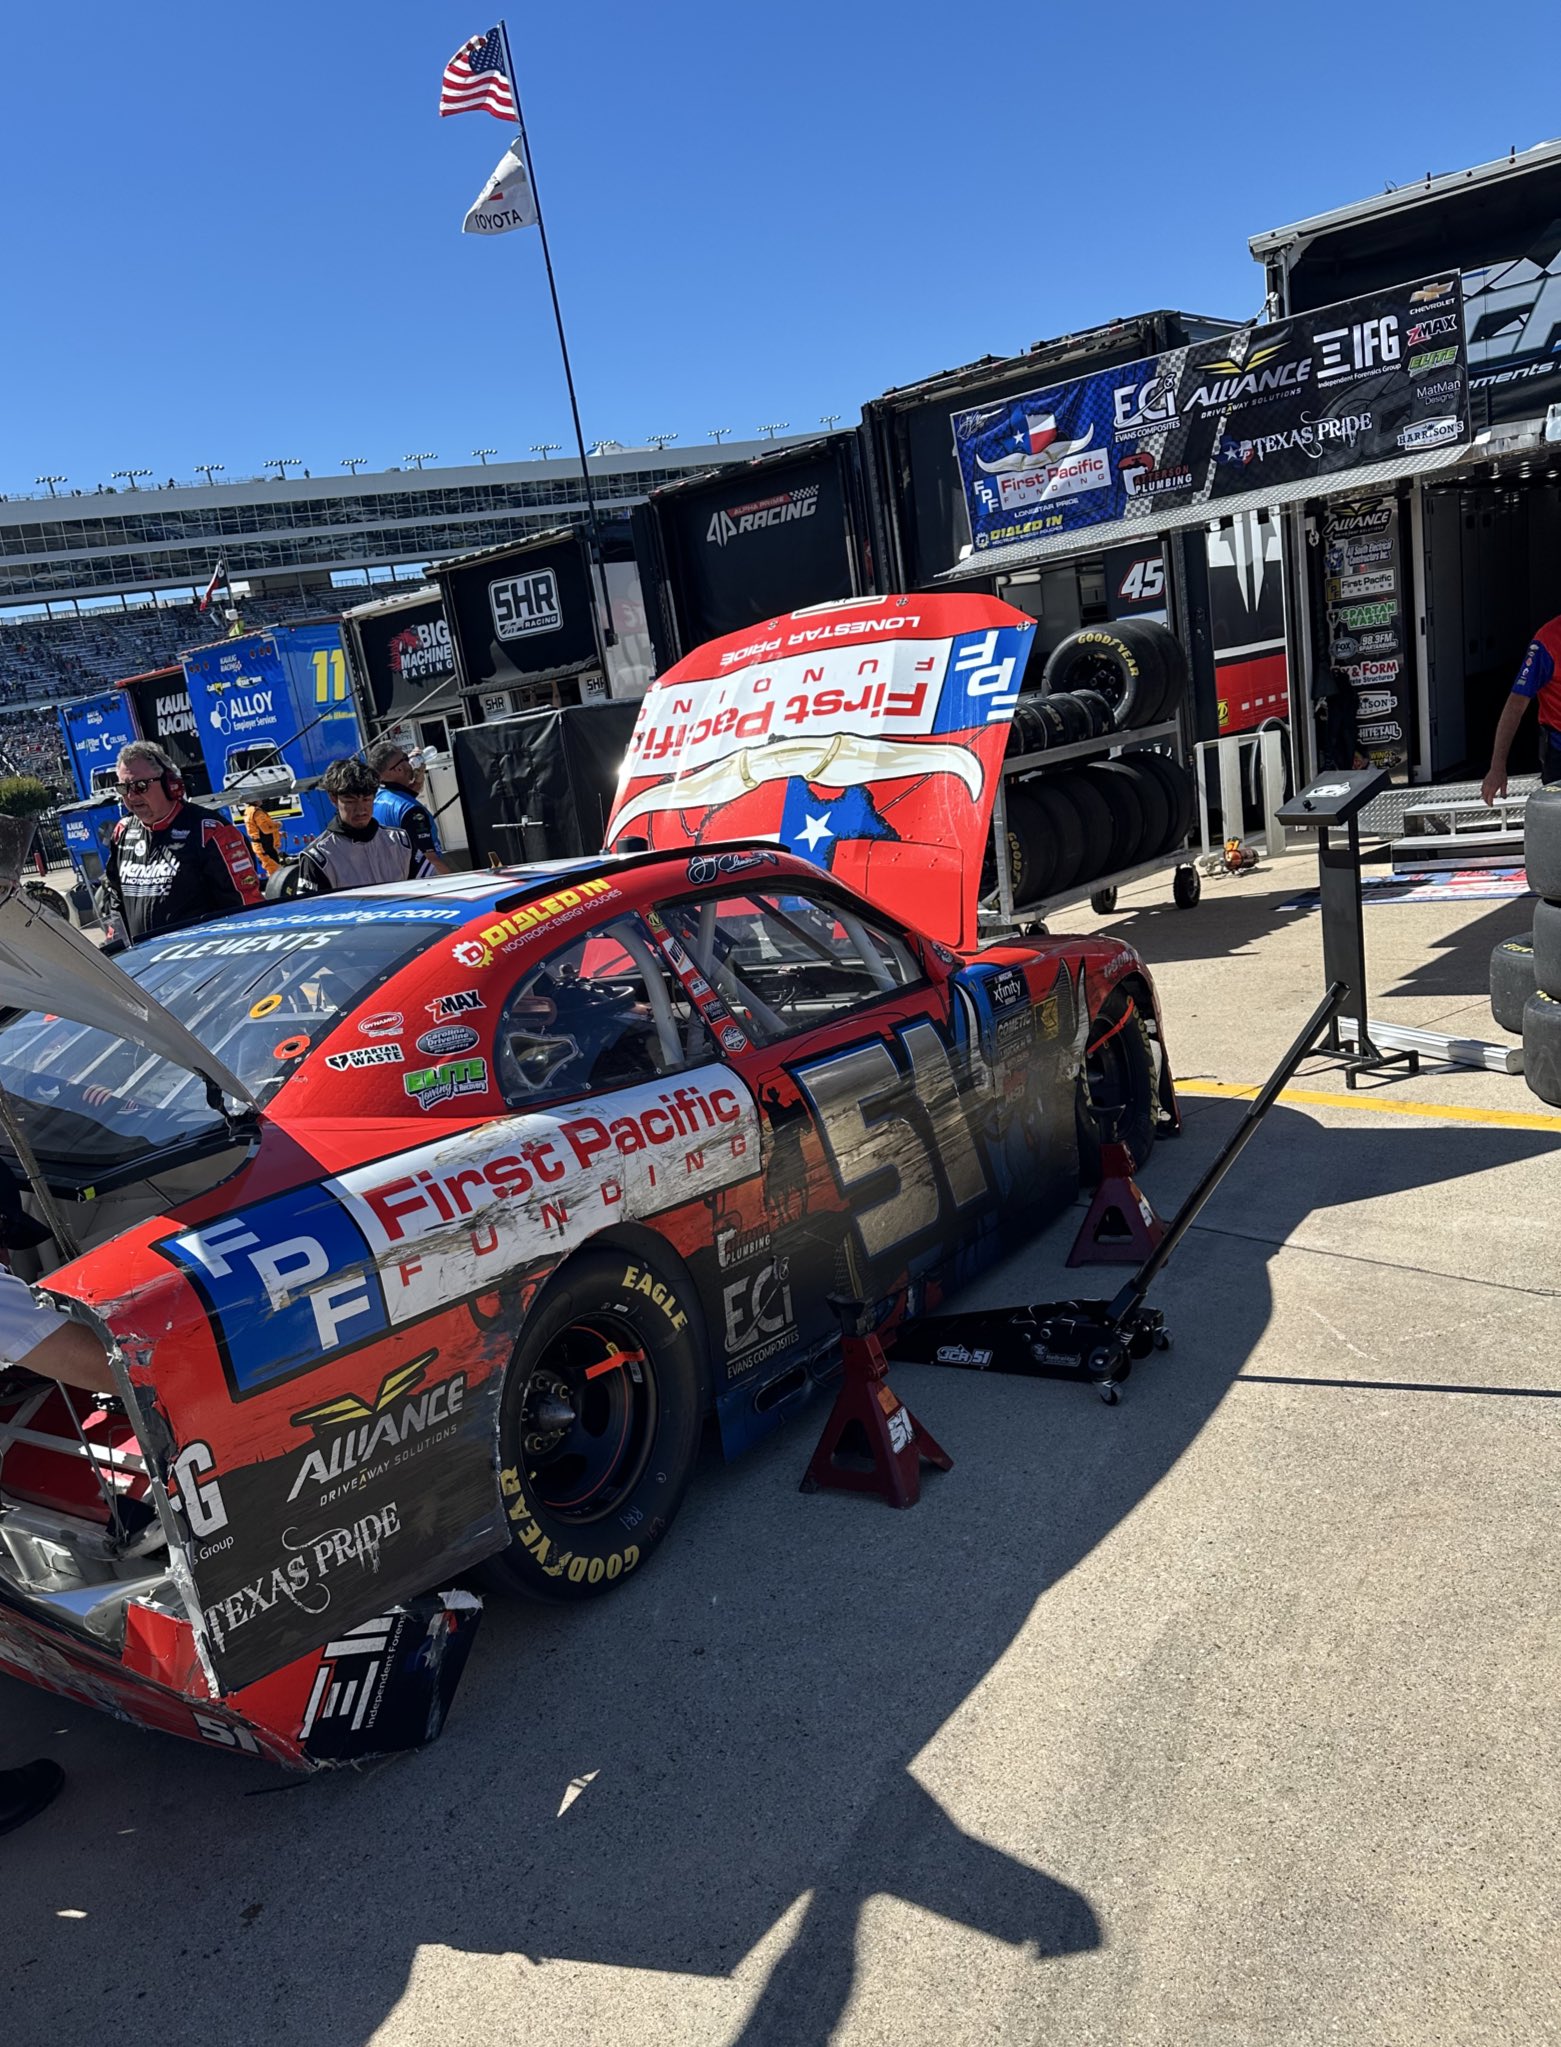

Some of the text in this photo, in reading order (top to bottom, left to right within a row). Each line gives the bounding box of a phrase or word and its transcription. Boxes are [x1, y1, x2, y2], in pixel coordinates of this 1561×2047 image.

[1409, 297, 1455, 315] CHEVROLET
[1409, 347, 1458, 370] ELITE
[1183, 357, 1312, 412] ALLIANCE
[1317, 374, 1353, 389] Independent
[1354, 365, 1381, 380] Forensics
[1381, 362, 1402, 377] Group
[1416, 379, 1460, 398] MatMan
[1201, 387, 1302, 419] DRIVEAWAY SOLUTIONS
[1425, 391, 1455, 406] Designs
[1115, 420, 1181, 444] EVANS COMPOSITES
[1251, 424, 1319, 460] TEXAS
[1317, 412, 1373, 447] PRIDE
[1001, 457, 1104, 494] First Pacific
[1003, 473, 1105, 504] FUNDING
[1135, 473, 1192, 494] PLUMBING
[733, 504, 758, 516] ALPHA
[739, 497, 817, 534] RACING
[1014, 497, 1079, 518] LONESTAR PRIDE
[990, 514, 1064, 540] DIALED IN
[1326, 511, 1390, 533] ALLIANCE
[1121, 558, 1164, 599] 45
[1342, 574, 1392, 589] First Pacific
[494, 575, 556, 621] SHR
[1341, 602, 1396, 618] SPARTAN
[418, 619, 451, 648] BIG
[521, 615, 558, 630] RACING
[1349, 613, 1389, 627] WASTE
[719, 615, 921, 667] LONESTAR PRIDE
[1077, 632, 1140, 677] GOODYEAR
[400, 645, 451, 668] MACHINE
[402, 659, 454, 680] RACING
[1352, 666, 1360, 678] &
[1362, 662, 1398, 676] FORM
[312, 649, 346, 703] 11
[156, 692, 192, 717] KAULI
[231, 691, 273, 719] ALLOY
[486, 696, 504, 711] SHR
[783, 682, 929, 724] First
[233, 714, 277, 732] Employer Services
[120, 854, 181, 883] Hendrick
[126, 876, 173, 886] MOTORSPORTS
[480, 878, 612, 948] DIALED IN
[501, 888, 623, 955] NOOTROPIC ENERGY POUCHES
[150, 930, 346, 963] CLEMENTS
[993, 980, 1021, 1004] xfinity
[364, 1015, 398, 1030] DYNAMIC
[425, 1027, 465, 1041] Carolina
[349, 1044, 399, 1059] SPARTAN
[351, 1051, 403, 1066] WASTE
[405, 1058, 486, 1094] ELITE
[418, 1083, 453, 1108] Towing
[796, 1022, 989, 1258] 51
[365, 1085, 742, 1242] First Pacific
[399, 1133, 748, 1288] FUNDING
[726, 1234, 771, 1265] PLUMBING
[177, 1217, 370, 1351] FPF
[621, 1265, 688, 1332] EAGLE
[727, 1331, 800, 1380] EVANS COMPOSITES
[971, 1350, 992, 1366] 51
[287, 1375, 465, 1502] ALLIANCE
[320, 1423, 457, 1507] DRIVEAWAY SOLUTIONS
[499, 1465, 640, 1584] GOODYEAR
[199, 1533, 235, 1561] Group
[204, 1502, 400, 1654] TEXAS PRIDE
[365, 1655, 396, 1729] Independent
[193, 1710, 261, 1754] 51
